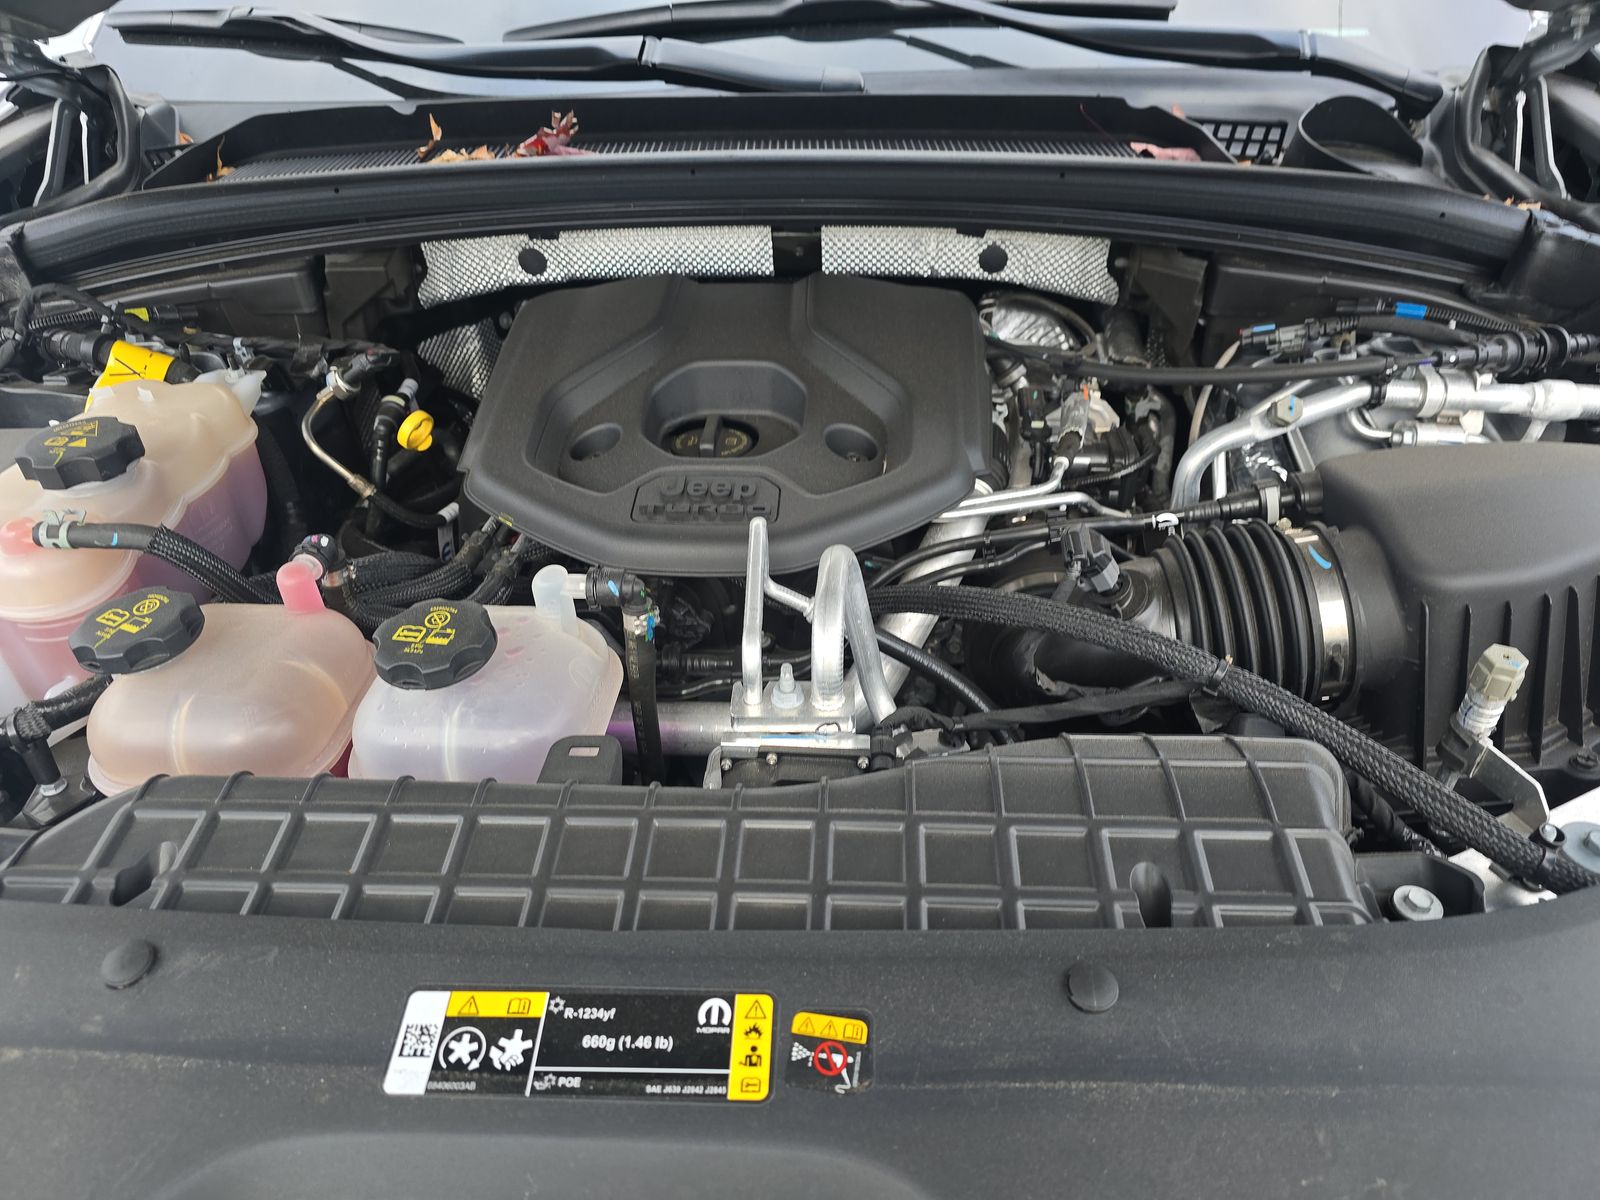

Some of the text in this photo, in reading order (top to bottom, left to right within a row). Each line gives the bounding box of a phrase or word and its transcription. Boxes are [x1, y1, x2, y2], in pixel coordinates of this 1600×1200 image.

[660, 474, 757, 501] Jeep
[564, 1007, 617, 1022] R-1234yf
[582, 1034, 674, 1052] 660g (1.46 lb)
[557, 1076, 582, 1089] POE
